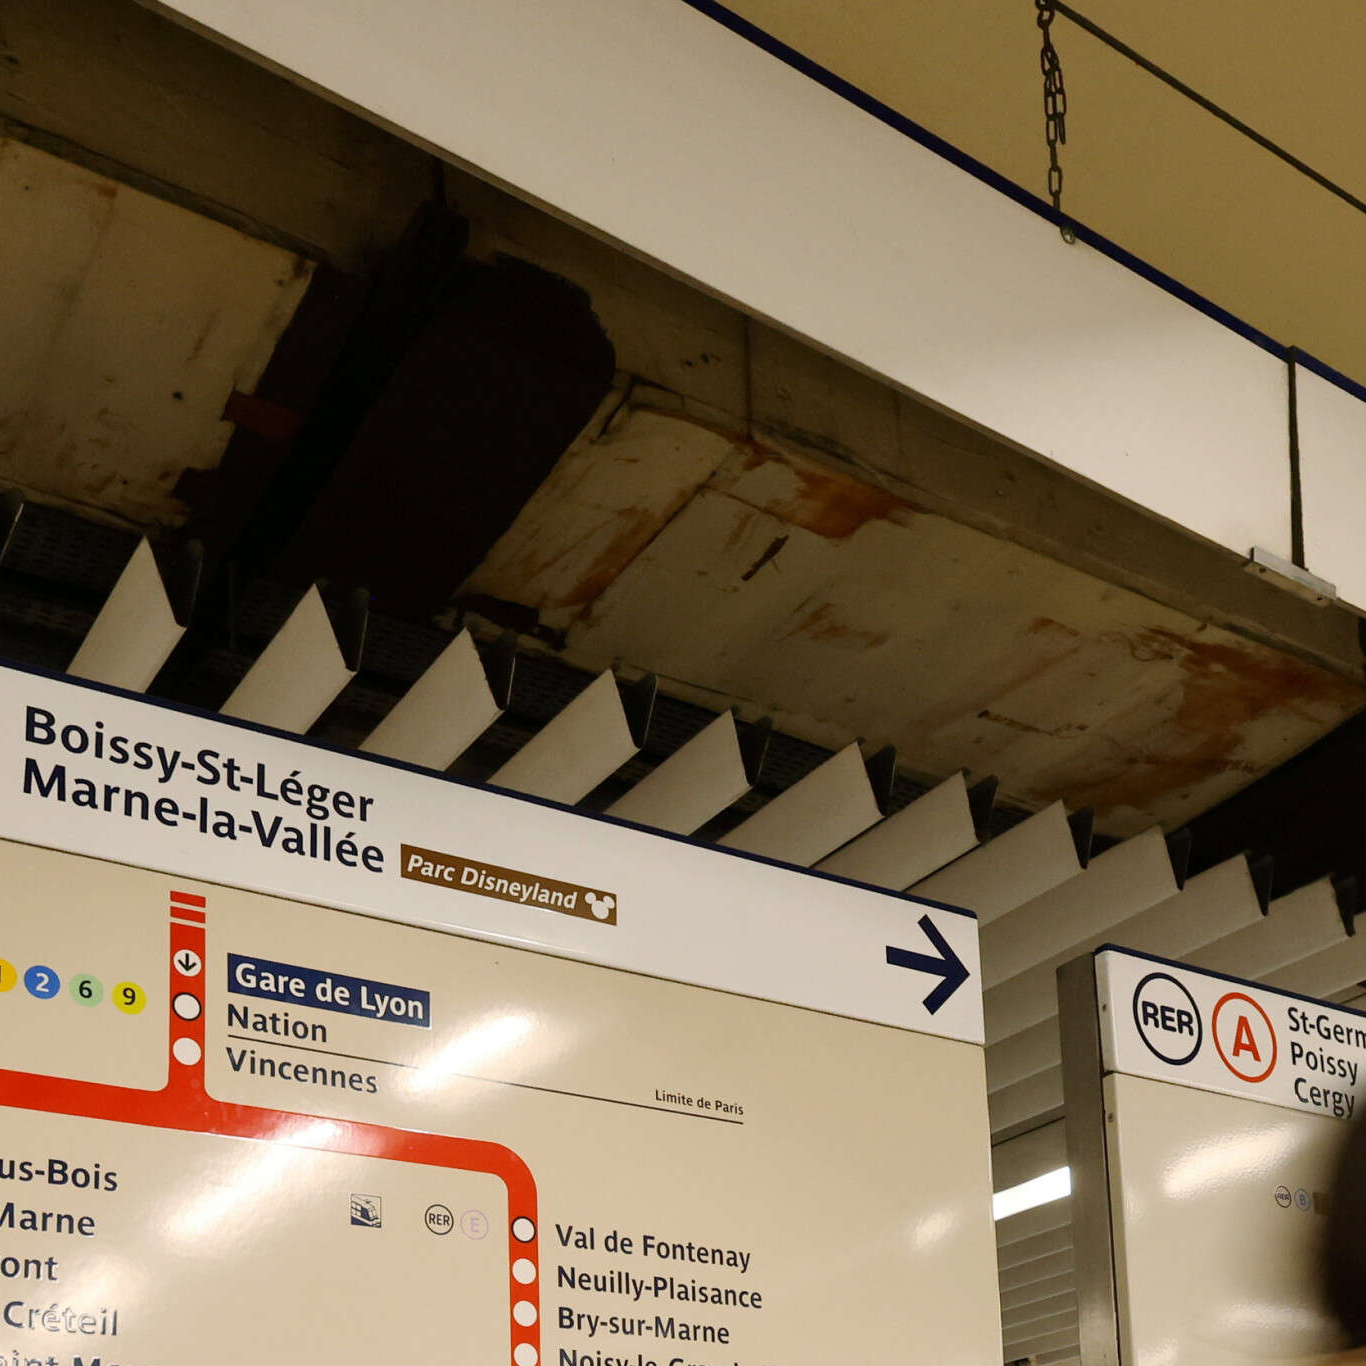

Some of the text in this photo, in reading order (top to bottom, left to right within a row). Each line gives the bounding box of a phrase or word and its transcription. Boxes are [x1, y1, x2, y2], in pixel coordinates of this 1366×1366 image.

[25, 705, 374, 822] Boissy-St-Léger
[23, 757, 384, 873] Marne-la-Vallée
[407, 853, 577, 910] Parc Disneyland
[36, 973, 50, 992] 2
[79, 980, 92, 998] 6
[123, 988, 136, 1006] 9
[235, 963, 424, 1019] Gare de Lyon
[227, 1004, 327, 1042] Nation
[1142, 1001, 1262, 1062] RER A
[226, 1047, 378, 1093] Vincennes
[1290, 1042, 1358, 1085] Poissy
[655, 1089, 744, 1115] Limite de Paris
[1294, 1078, 1355, 1119] Cergy
[429, 1213, 480, 1232] RER E
[555, 1224, 751, 1273] Val de Fontenay
[558, 1265, 762, 1309] Neuilly-Plaisance
[4, 1301, 118, 1336] Créteil
[558, 1307, 730, 1344] Bry-sur-Marne
